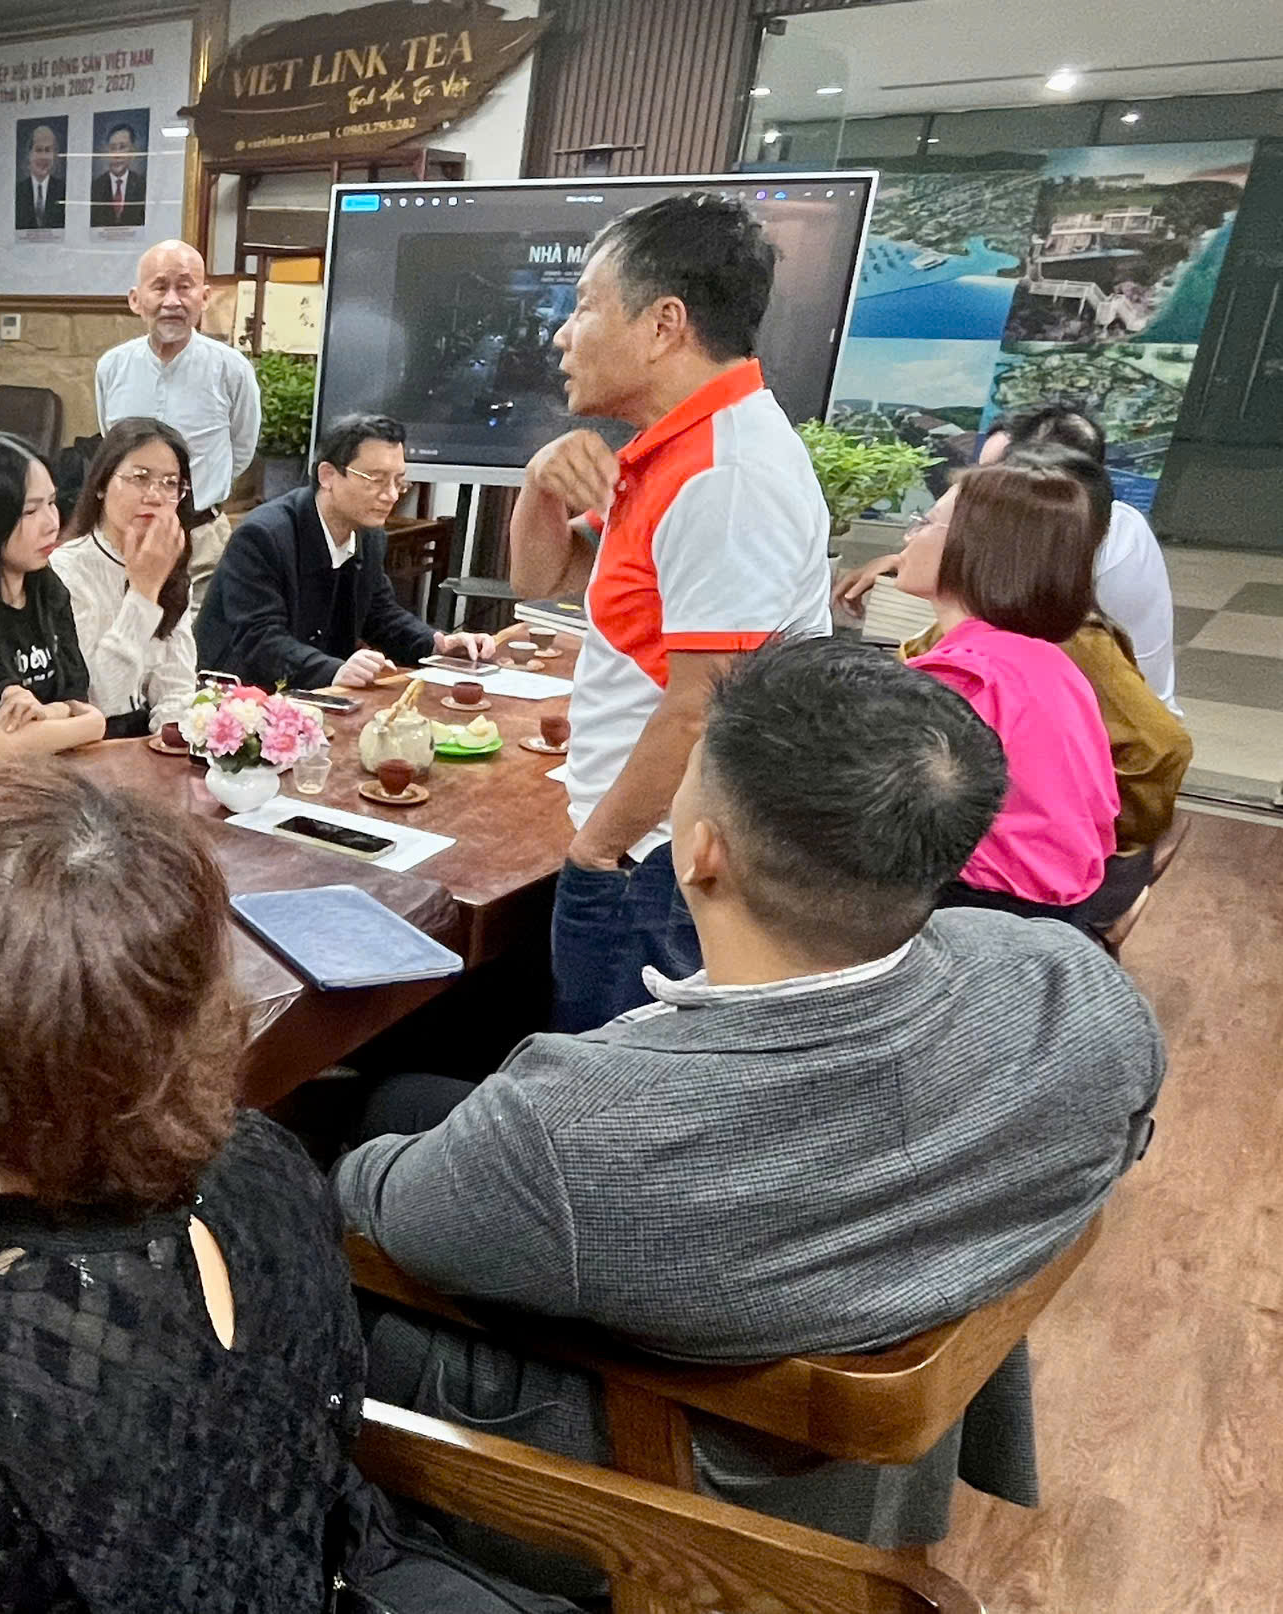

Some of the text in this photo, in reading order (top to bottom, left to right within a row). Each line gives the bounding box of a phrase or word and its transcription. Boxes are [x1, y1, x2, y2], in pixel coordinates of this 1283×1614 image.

[231, 30, 474, 98] VIET LINK TEA
[528, 242, 563, 264] NHÀ
